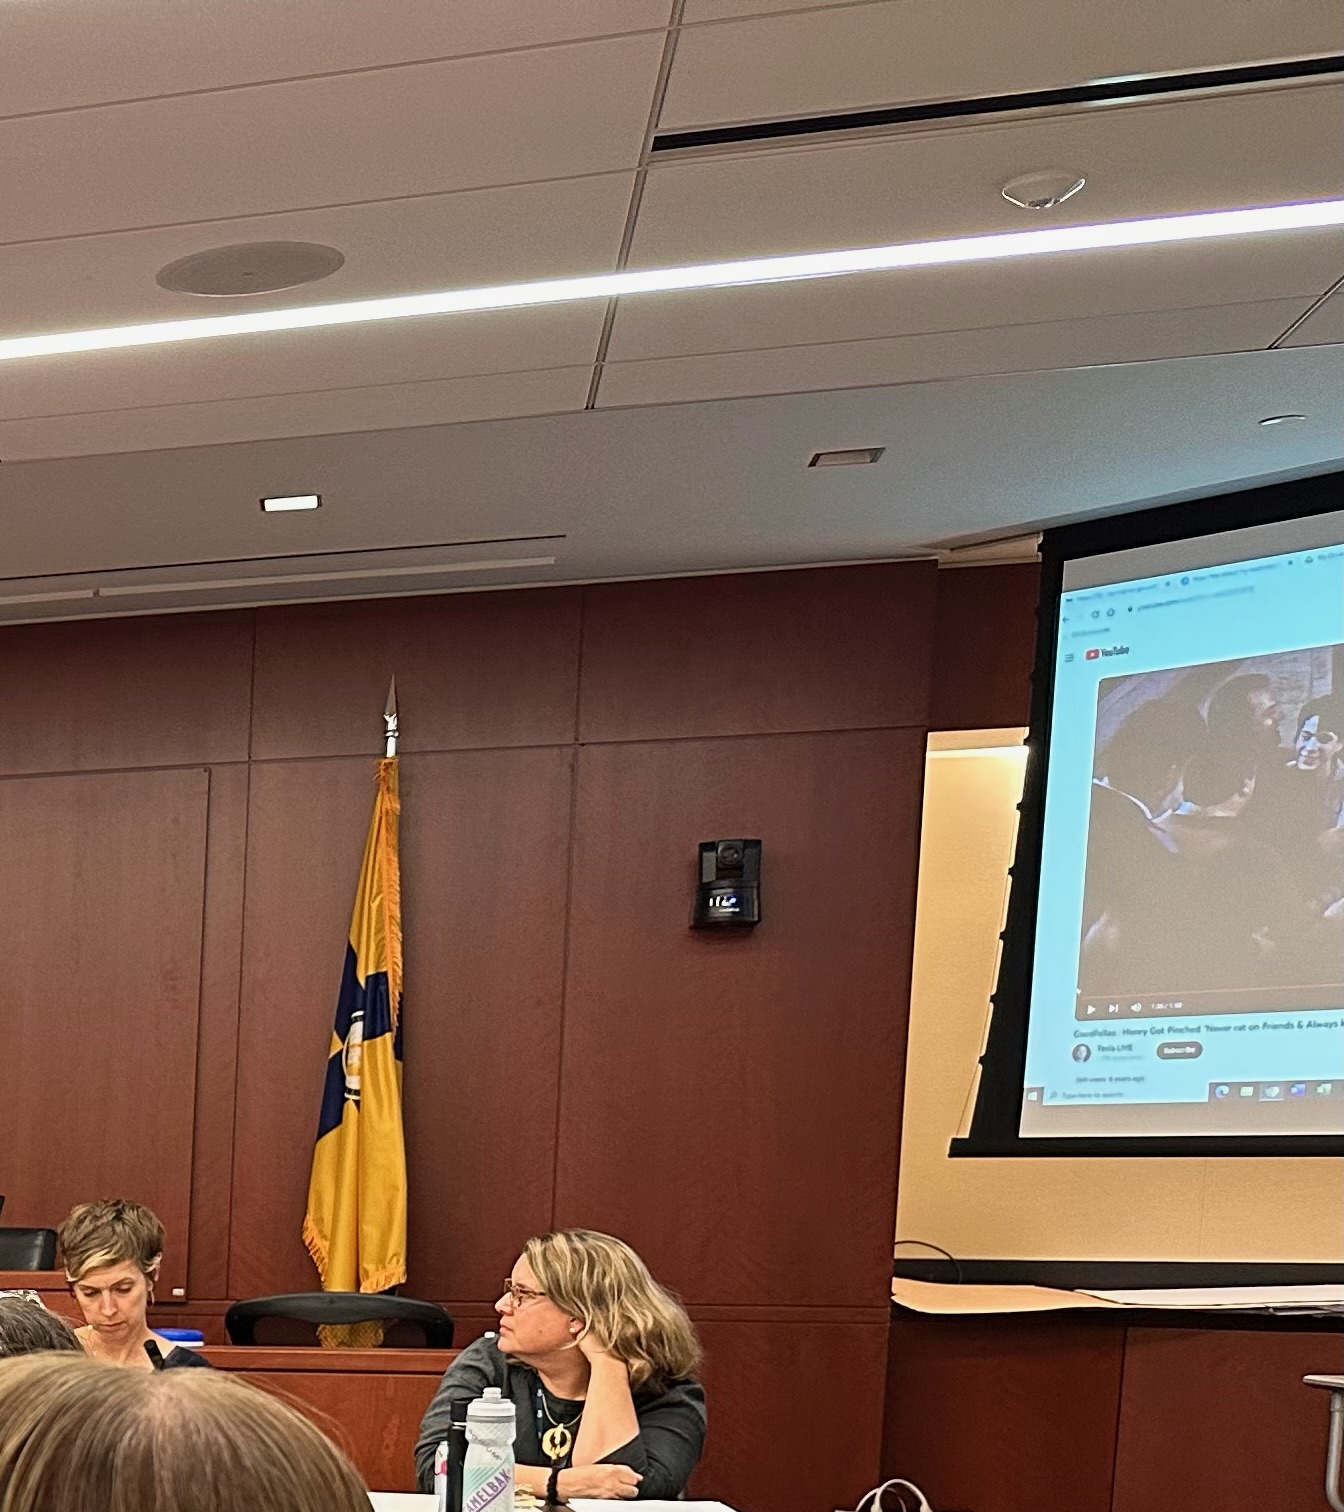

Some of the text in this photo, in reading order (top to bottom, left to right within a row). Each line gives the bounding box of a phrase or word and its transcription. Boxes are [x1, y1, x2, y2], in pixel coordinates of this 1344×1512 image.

[1101, 645, 1130, 657] YouTube
[1122, 1028, 1148, 1036] Henry
[1150, 1026, 1165, 1035] Got
[1167, 1025, 1201, 1034] Pinched
[1262, 1021, 1295, 1030] Friends
[1305, 1020, 1338, 1029] Always
